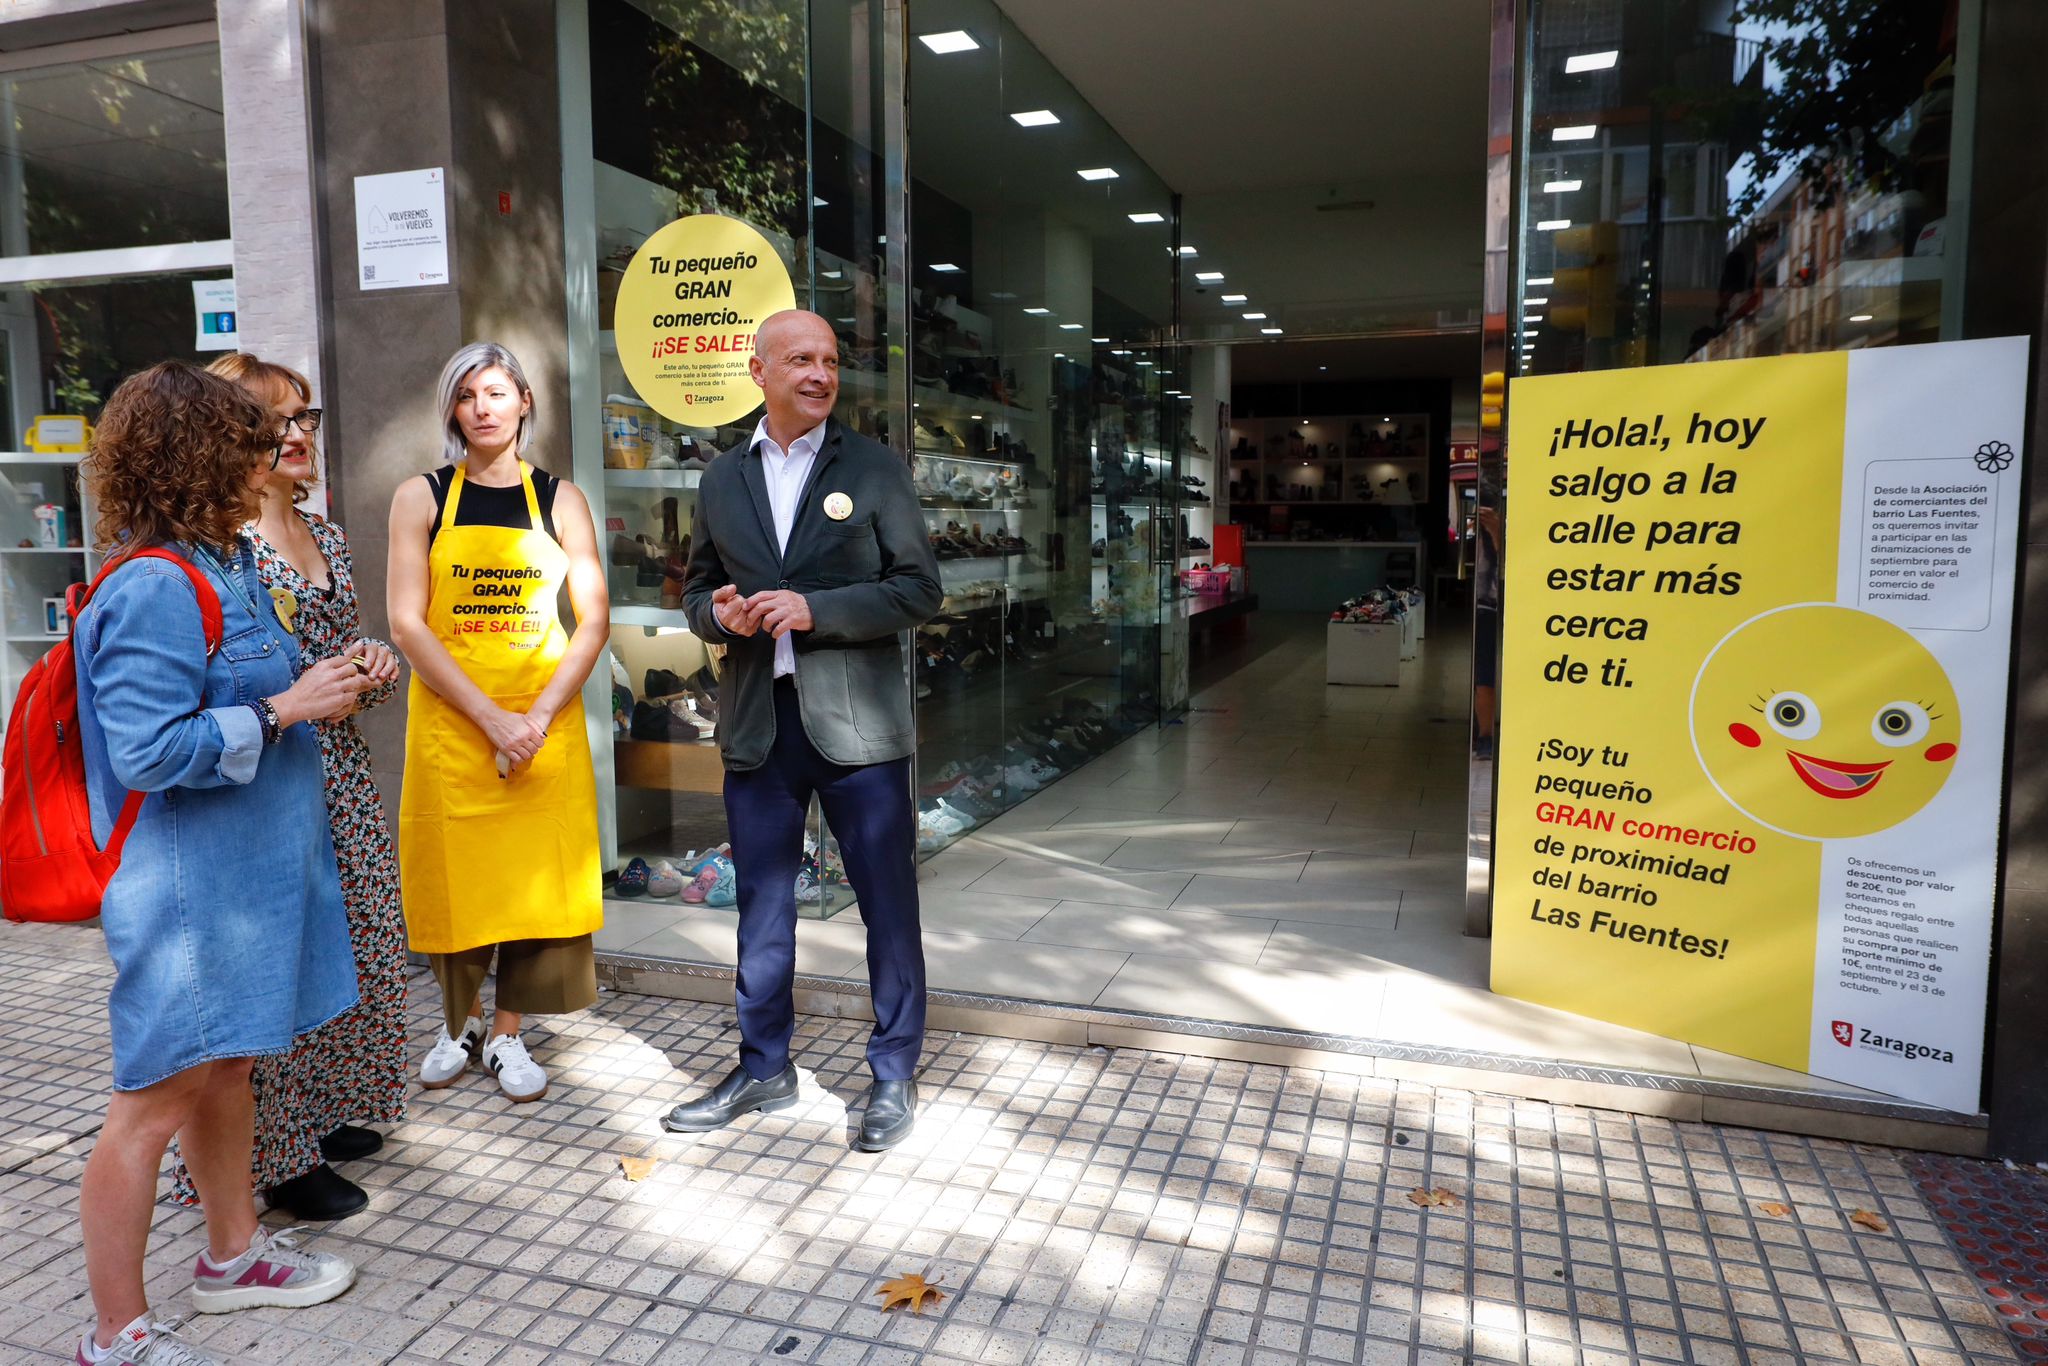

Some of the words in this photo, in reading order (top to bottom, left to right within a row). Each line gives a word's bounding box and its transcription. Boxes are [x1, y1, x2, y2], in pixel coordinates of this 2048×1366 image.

[388, 209, 428, 222] VOLVEREMOS
[406, 218, 432, 230] VUELVES
[650, 257, 670, 274] Tu
[675, 252, 757, 276] pequeño
[676, 280, 732, 300] GRAN
[653, 308, 754, 327] comercio...
[652, 337, 689, 358] ¡¡SE
[694, 334, 756, 353] SALE!!
[694, 395, 724, 403] Zaragoza
[1549, 414, 1671, 456] ¡Hola!,
[1686, 412, 1766, 450] hoy
[1549, 466, 1651, 503] salgo
[1663, 471, 1687, 495] a
[1700, 463, 1737, 494] la
[1874, 486, 1908, 495] Desde
[1911, 486, 1920, 494] la
[1923, 485, 1987, 494] Asociación
[1890, 497, 1966, 506] comerciantes
[1931, 509, 1980, 519] Fuentes,
[1548, 514, 1635, 544] calle
[1645, 521, 1741, 551] para
[1888, 522, 1941, 531] queremos
[1944, 521, 1978, 529] invitar
[1881, 534, 1932, 543] participar
[1871, 546, 1954, 554] dinamizaciones
[1957, 546, 1971, 554] de
[452, 564, 469, 578] Tu
[472, 566, 542, 580] pequeño
[1870, 557, 1929, 566] septiembre
[1933, 558, 1958, 567] para
[1547, 563, 1645, 592] estar
[1654, 563, 1742, 595] más
[1869, 570, 1900, 578] poner
[1920, 569, 1946, 577] valor
[473, 584, 521, 596] GRAN
[1868, 592, 1931, 602] proximidad.
[452, 603, 538, 614] comercio...
[453, 621, 485, 635] ¡¡SE
[489, 621, 540, 633] SALE!!
[1545, 614, 1648, 640] cerca
[1544, 654, 1588, 684] de
[1600, 658, 1633, 687] ti.
[1537, 738, 1594, 767] ¡Soy
[1601, 746, 1629, 767] tu
[1535, 774, 1653, 804] pequeño
[1535, 802, 1615, 832] GRAN
[1622, 820, 1757, 854] comercio
[1533, 835, 1565, 856] de
[1571, 844, 1730, 885] proximidad
[1848, 857, 1862, 866] Os
[1864, 860, 1920, 875] ofrecemos
[1532, 867, 1572, 890] del
[1577, 874, 1658, 907] barrio
[1846, 880, 1859, 889] de
[1862, 882, 1884, 894] 20€,
[1886, 887, 1906, 897] que
[1847, 869, 1902, 884] descuento
[1905, 878, 1924, 888] por
[1927, 882, 1955, 892] valor
[1845, 891, 1899, 907] sorteamos
[1844, 902, 1888, 917] cheques
[1891, 910, 1924, 924] regalo
[1927, 918, 1955, 927] entre
[1844, 914, 1873, 924] todas
[1875, 920, 1919, 933] aquellas
[1530, 899, 1581, 929] Las
[1589, 910, 1729, 960] Fuentes!
[1843, 925, 1890, 940] personas
[1893, 934, 1914, 945] que
[1916, 938, 1959, 952] realicen
[1843, 936, 1855, 945] su
[1857, 939, 1898, 953] compra
[1901, 948, 1920, 958] por
[1923, 951, 1936, 960] un
[1842, 946, 1882, 961] importe
[1885, 955, 1926, 969] mínimo
[1928, 963, 1943, 972] de
[1842, 958, 1862, 969] 10€,
[1865, 963, 1892, 974] entre
[1894, 968, 1904, 976] el
[1906, 970, 1920, 980] 23
[1922, 972, 1936, 983] de
[1840, 969, 1898, 988] septiembre
[1900, 981, 1907, 990] y
[1909, 982, 1919, 991] el
[1921, 985, 1928, 993] 3
[1931, 987, 1945, 997] de
[1840, 980, 1882, 995] octubre.
[1860, 1028, 1953, 1064] Zaragoza
